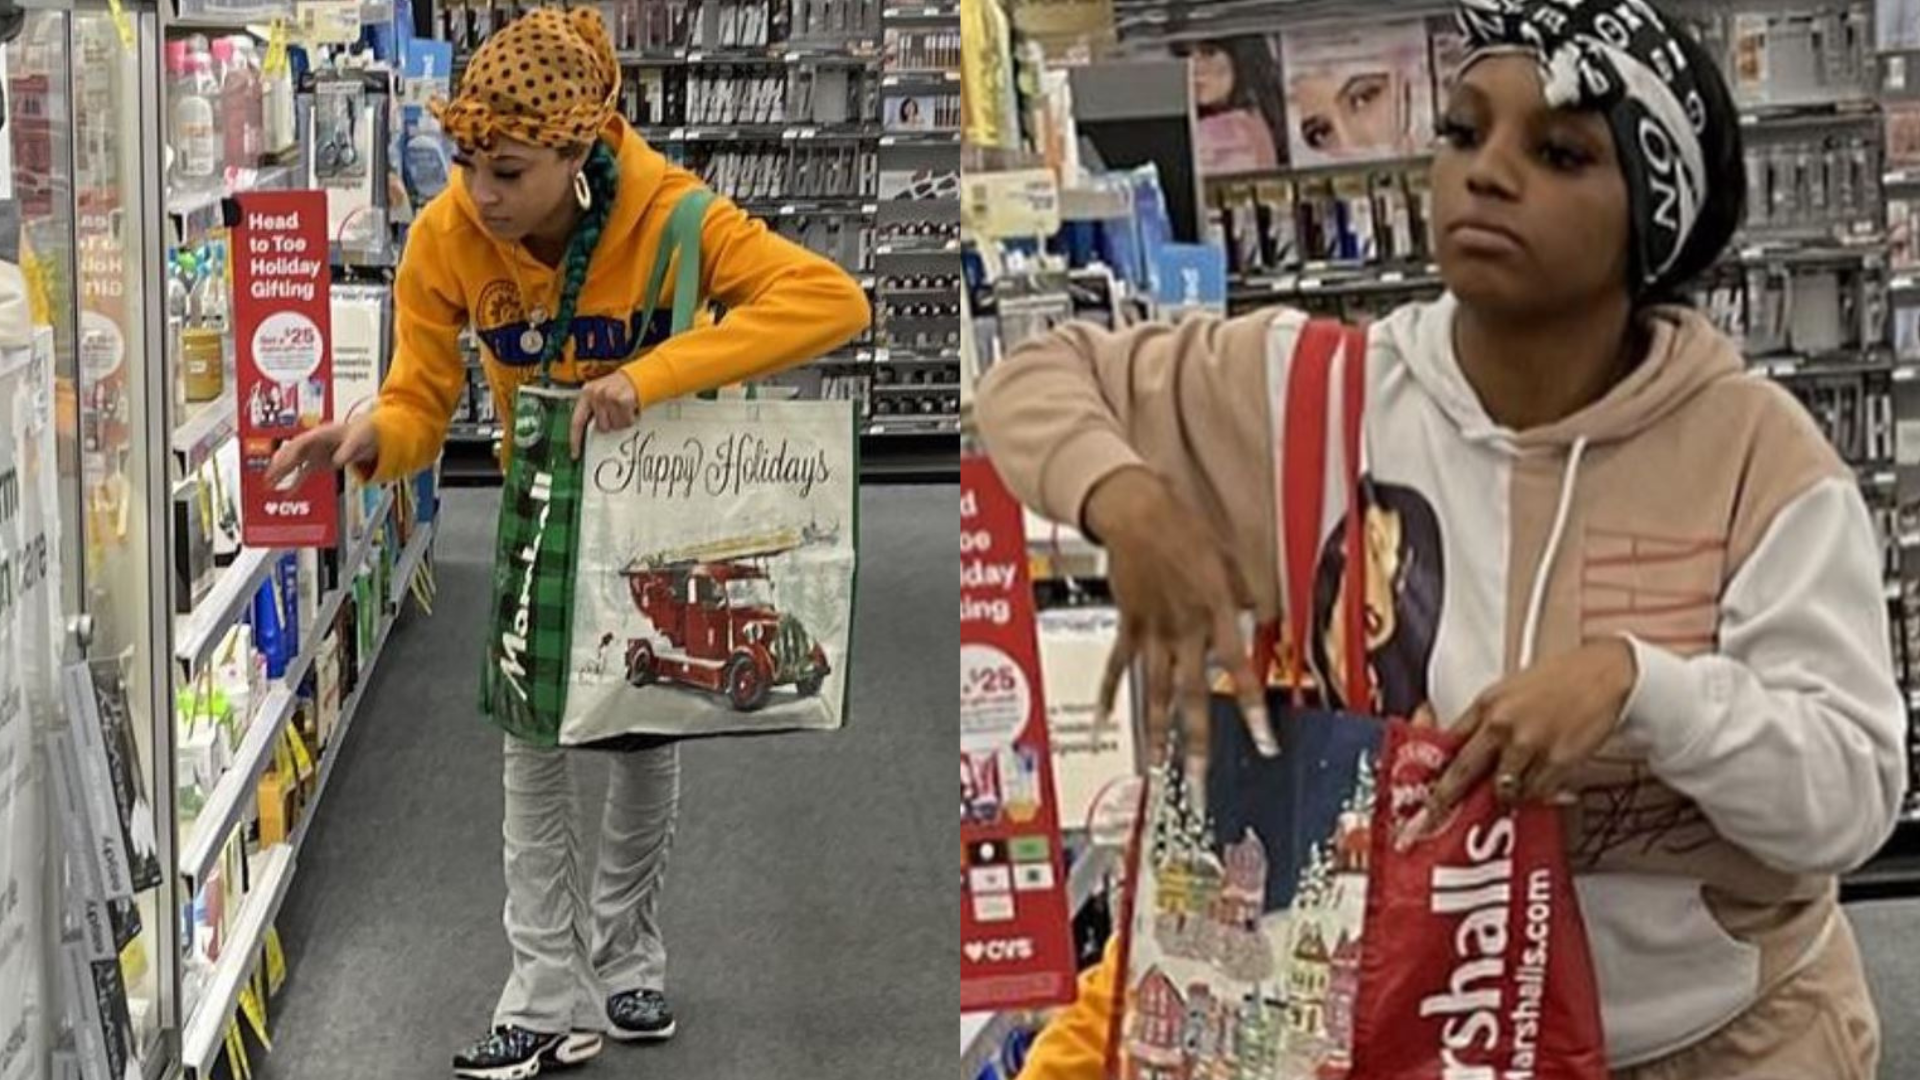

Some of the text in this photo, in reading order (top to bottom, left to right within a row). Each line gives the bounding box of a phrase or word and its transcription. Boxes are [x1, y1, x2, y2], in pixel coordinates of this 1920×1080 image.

[248, 211, 299, 230] Head
[250, 235, 307, 253] to Toe
[250, 257, 321, 279] Holiday
[250, 280, 315, 301] Gifting
[594, 431, 829, 498] Happy Holidays
[280, 502, 310, 515] CVS
[986, 938, 1033, 960] CVS
